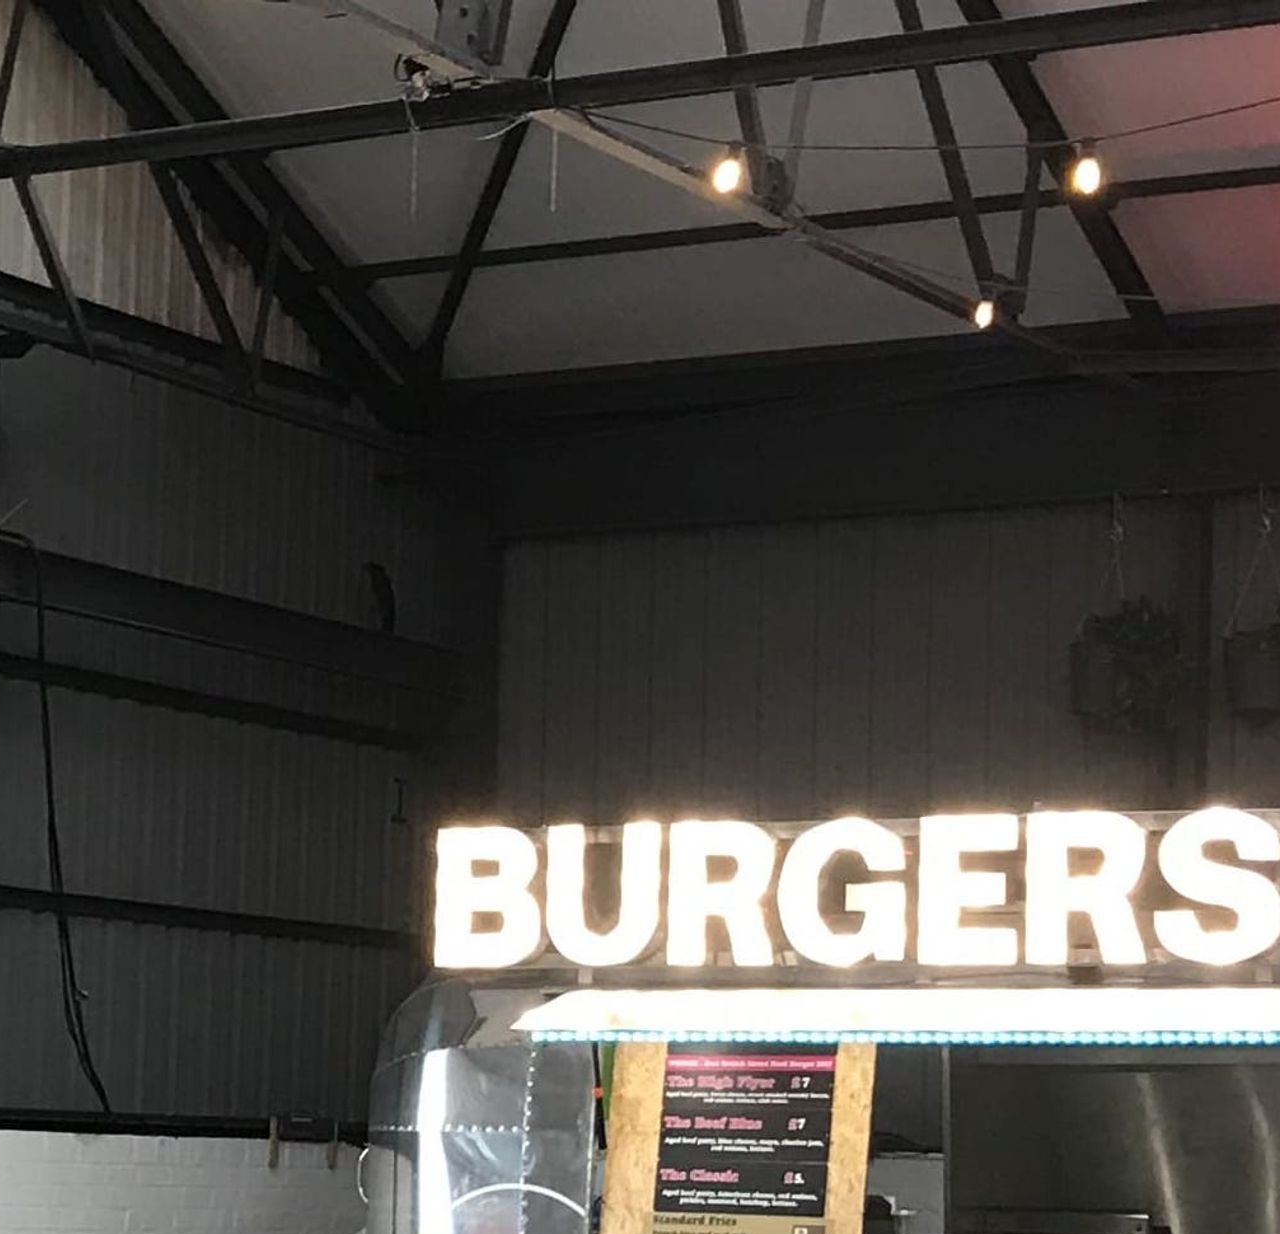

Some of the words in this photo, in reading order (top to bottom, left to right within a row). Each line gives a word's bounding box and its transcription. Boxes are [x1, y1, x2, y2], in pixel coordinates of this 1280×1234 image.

[667, 1075, 694, 1088] The
[664, 1116, 691, 1130] The
[660, 1168, 687, 1181] The
[689, 1168, 739, 1184] Classic
[652, 1214, 705, 1226] Standard
[708, 1215, 737, 1227] Fries
